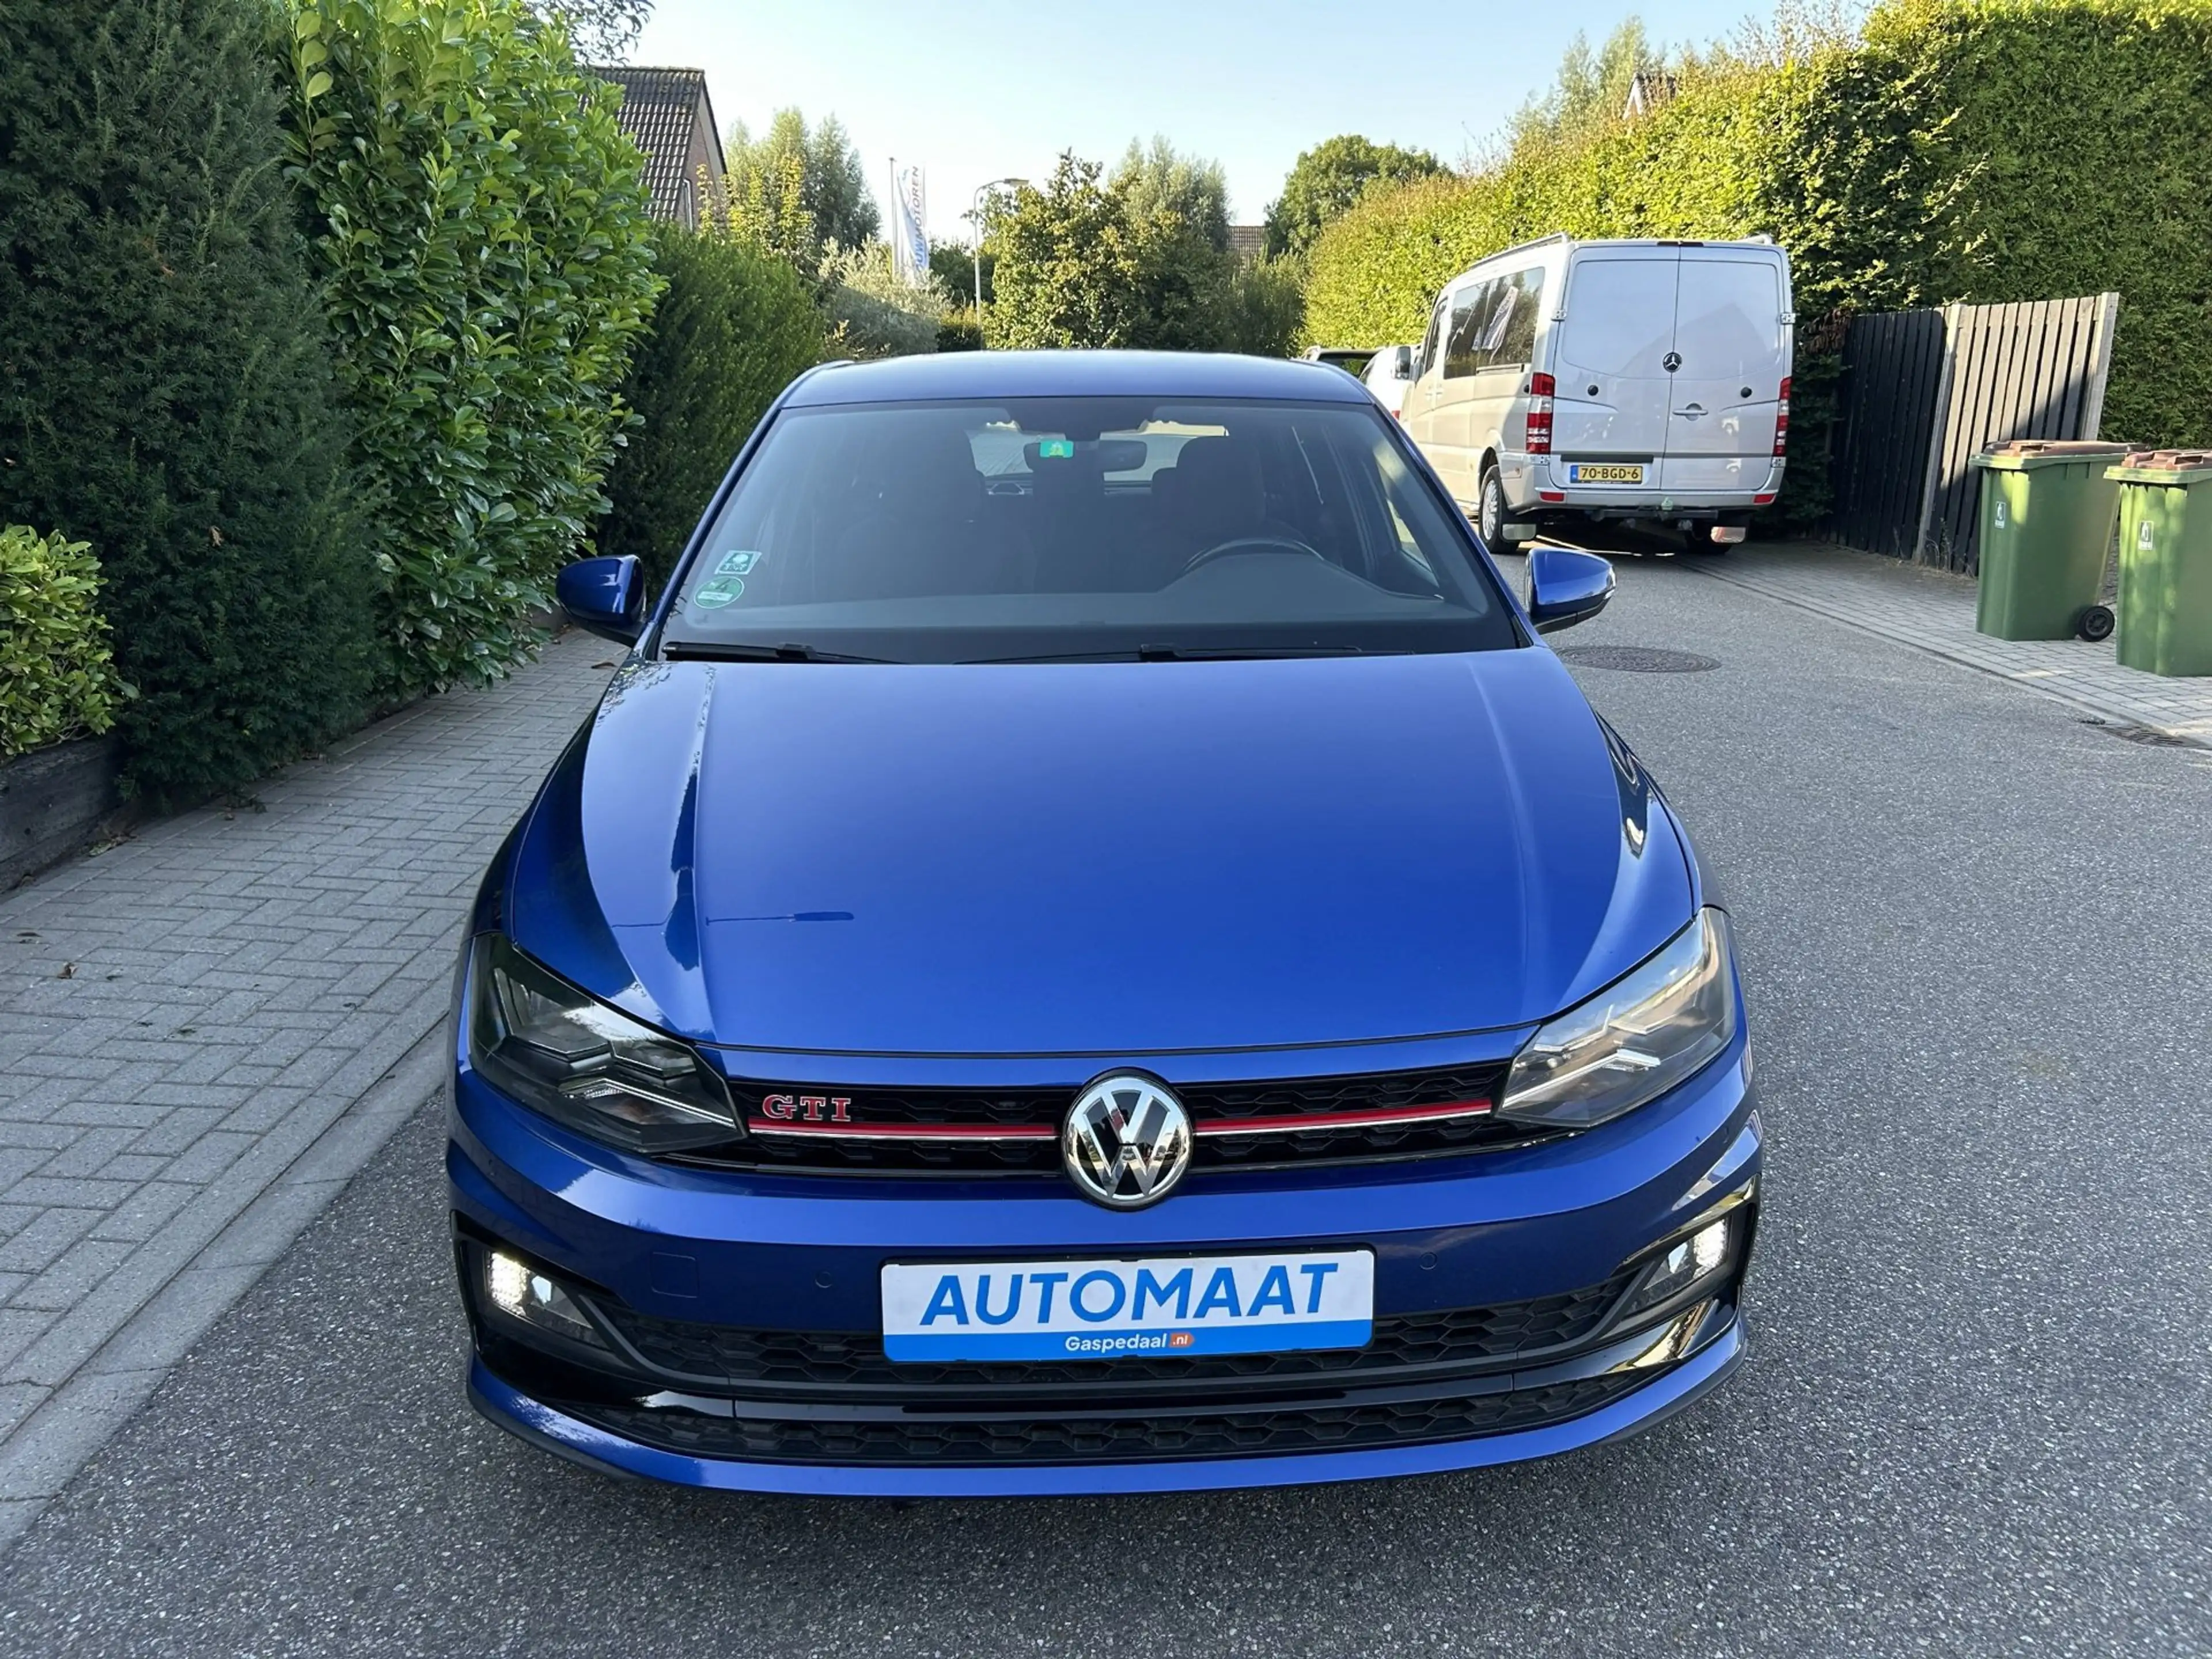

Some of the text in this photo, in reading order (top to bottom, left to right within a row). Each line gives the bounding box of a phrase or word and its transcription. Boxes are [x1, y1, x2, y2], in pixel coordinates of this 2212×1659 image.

[1581, 467, 1639, 479] 70-BGD-6
[762, 1094, 851, 1122] GTI
[920, 1262, 1339, 1326] AUTOMAAT
